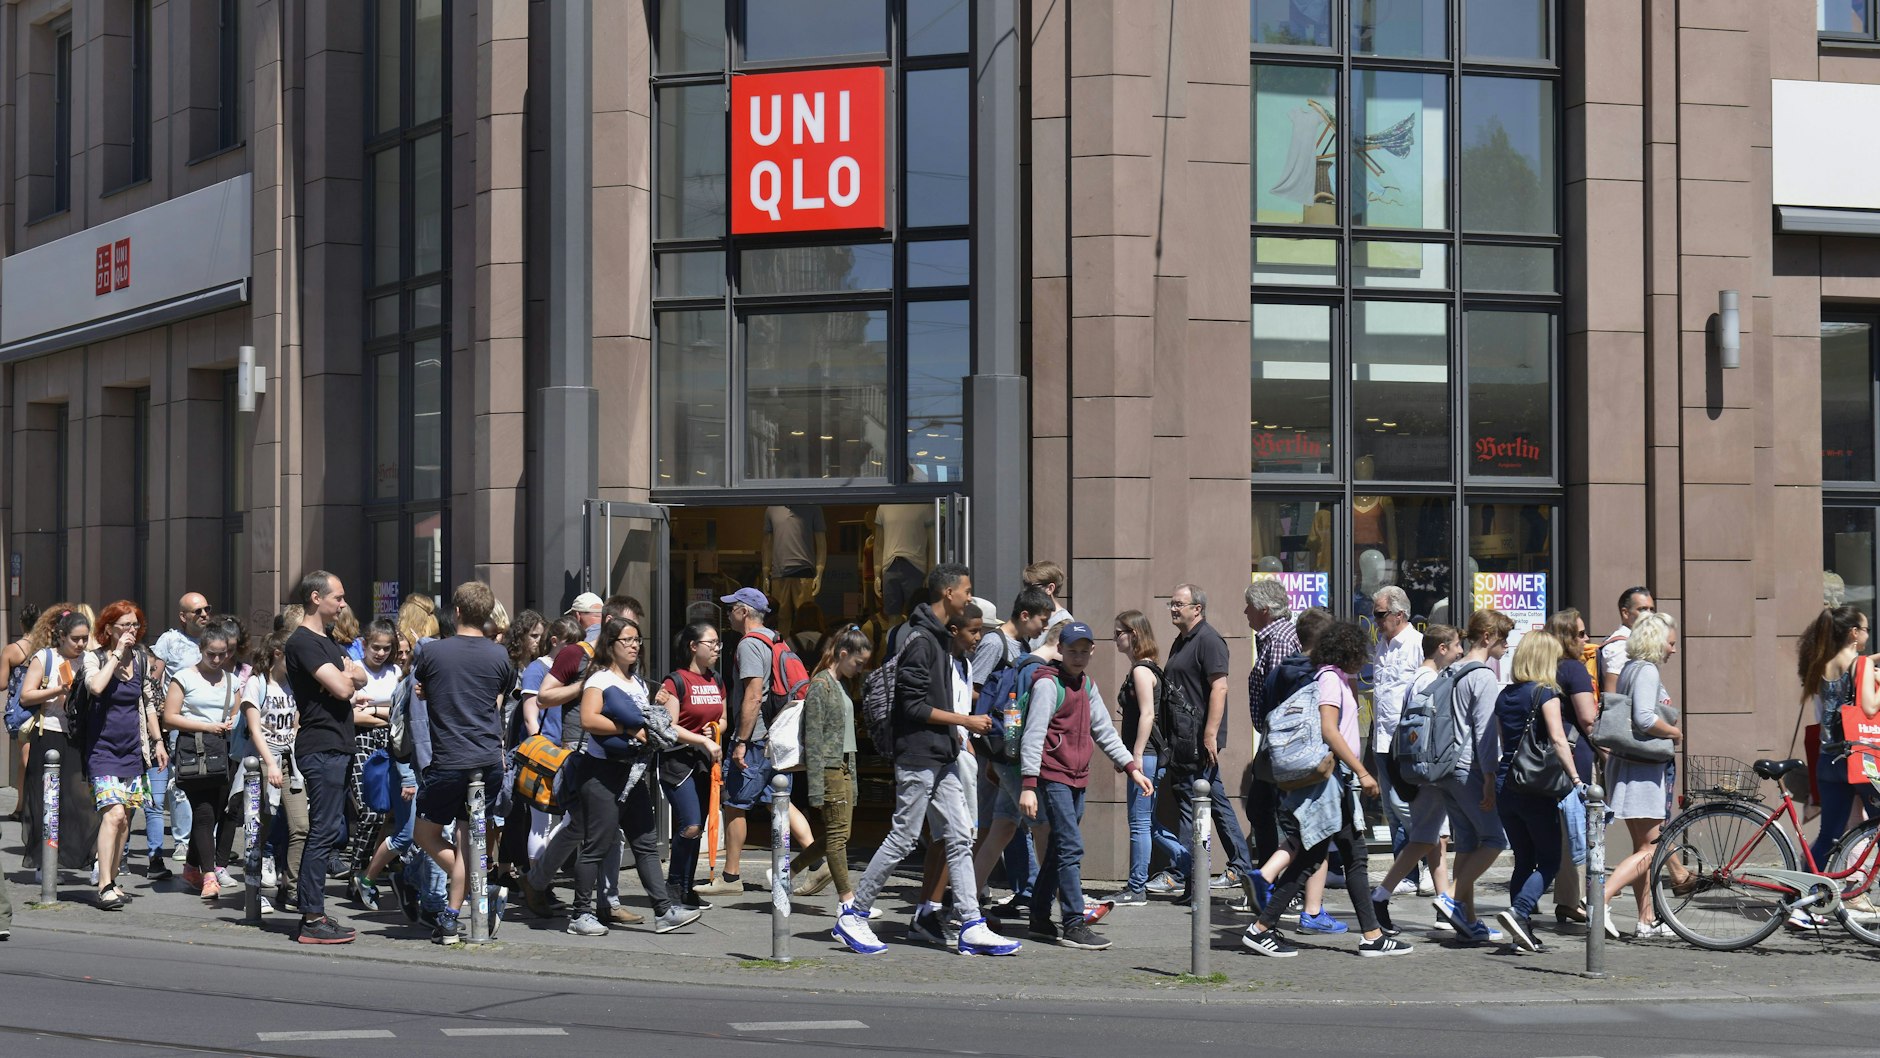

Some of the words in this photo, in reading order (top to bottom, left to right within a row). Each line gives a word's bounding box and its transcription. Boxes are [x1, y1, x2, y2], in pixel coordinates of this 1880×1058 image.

[750, 90, 850, 146] UNI
[750, 155, 861, 221] QLO
[116, 245, 128, 263] UNI
[116, 264, 129, 286] QLO
[1252, 432, 1321, 458] Berlin
[1475, 436, 1539, 461] Berlin
[1474, 574, 1545, 592] SOMMER
[1474, 594, 1546, 610] SPECIALS
